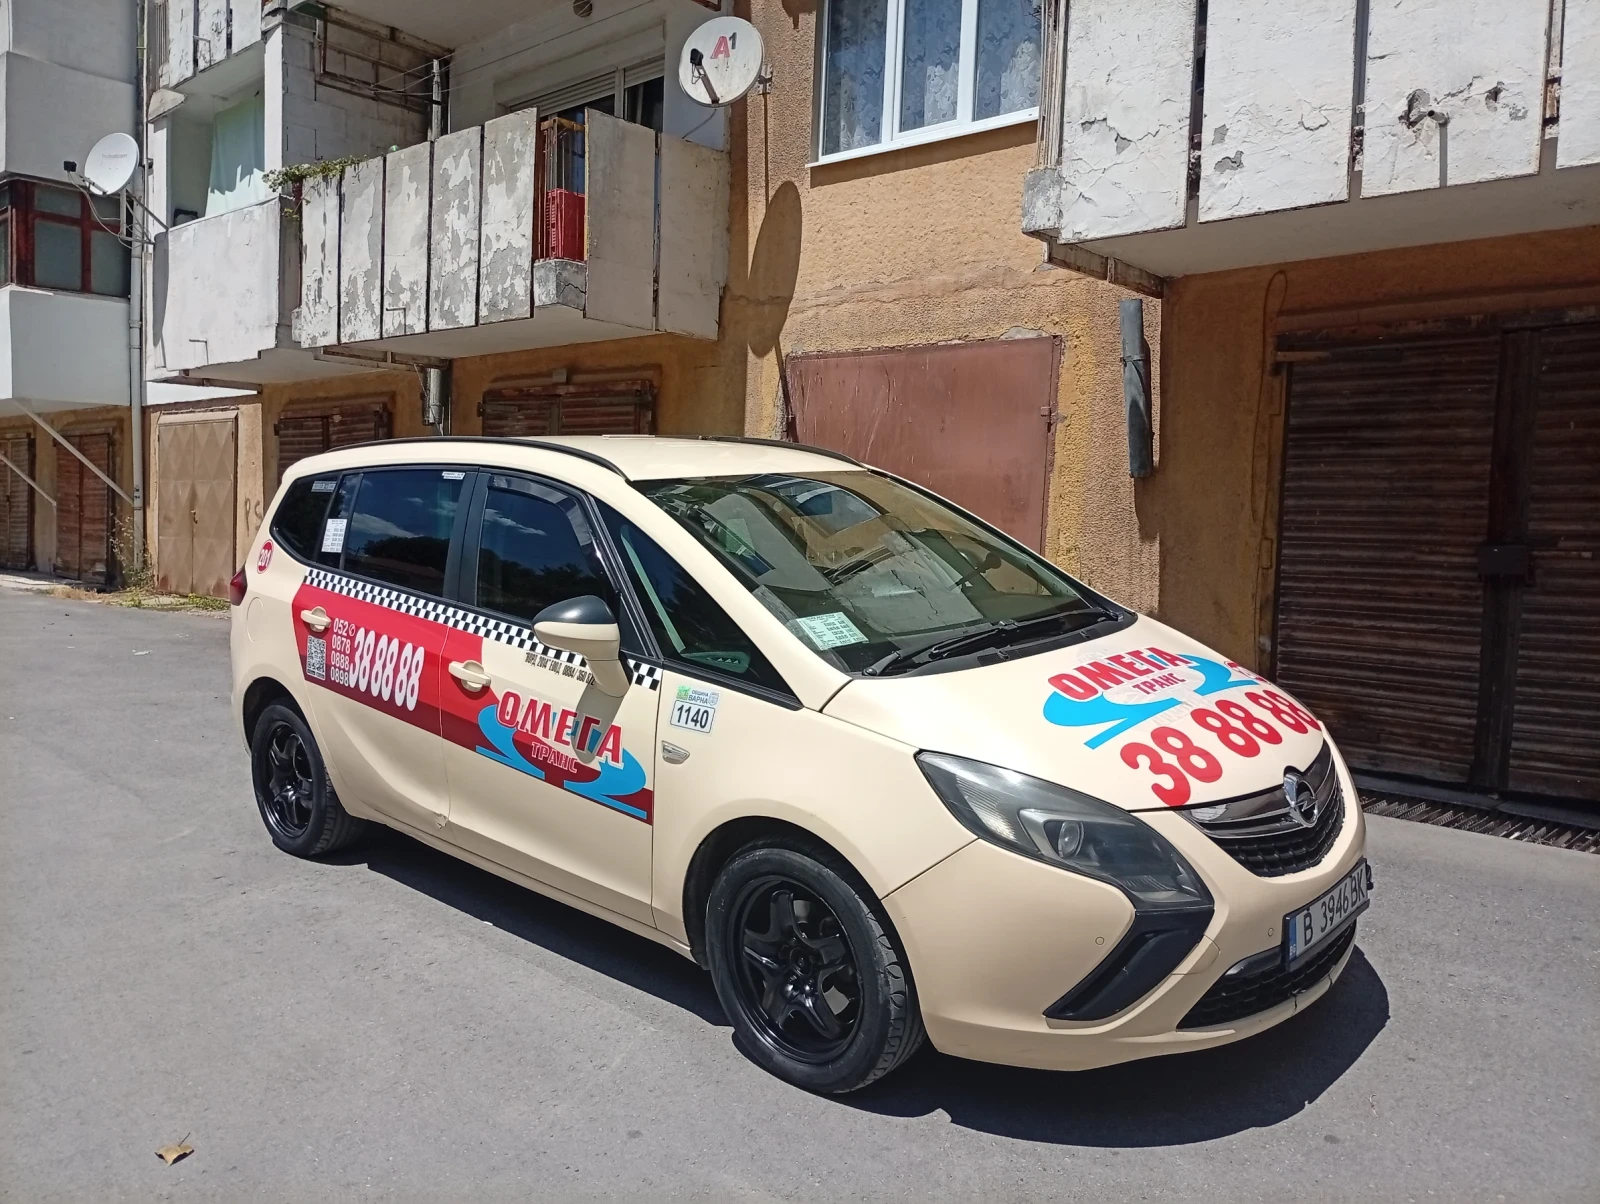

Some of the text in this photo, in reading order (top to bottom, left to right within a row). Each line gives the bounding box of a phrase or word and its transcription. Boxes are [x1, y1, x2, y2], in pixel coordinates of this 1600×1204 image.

[710, 32, 737, 59] A1
[333, 618, 349, 636] 052
[331, 634, 351, 654] 0878
[330, 650, 350, 671] 0888
[330, 667, 349, 687] 0898
[1047, 647, 1193, 700] ОМЕГА
[1131, 672, 1187, 695] ТРАНС
[688, 694, 709, 705] ВАРНА
[498, 690, 623, 766] ОМЕГА
[677, 704, 709, 729] 1140
[531, 741, 577, 773] ТРАНС
[1120, 726, 1223, 807] 38
[1190, 699, 1283, 758] 88
